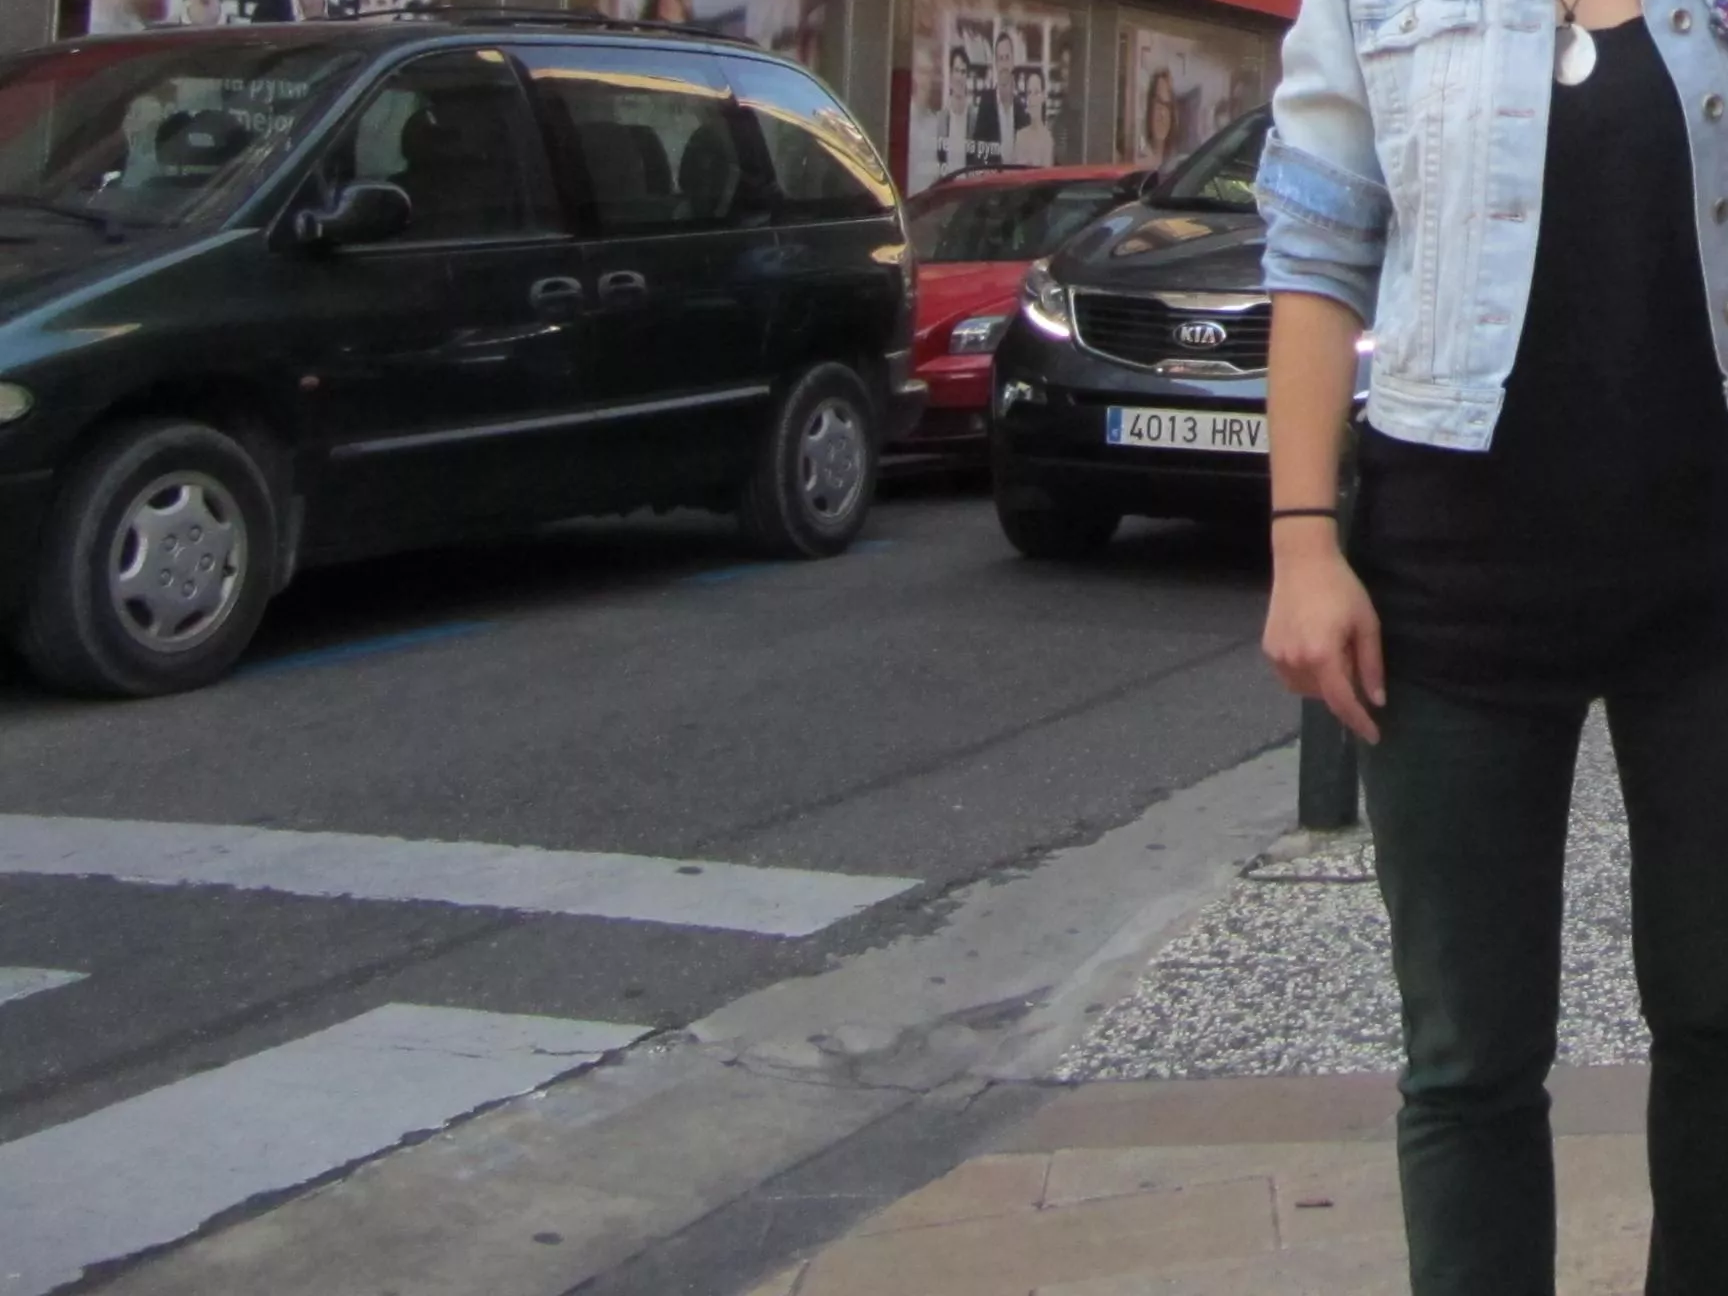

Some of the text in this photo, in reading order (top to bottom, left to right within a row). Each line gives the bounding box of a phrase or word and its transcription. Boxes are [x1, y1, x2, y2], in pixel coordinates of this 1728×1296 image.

[1180, 326, 1216, 344] KIA
[1129, 413, 1261, 446] 4013 HRV
